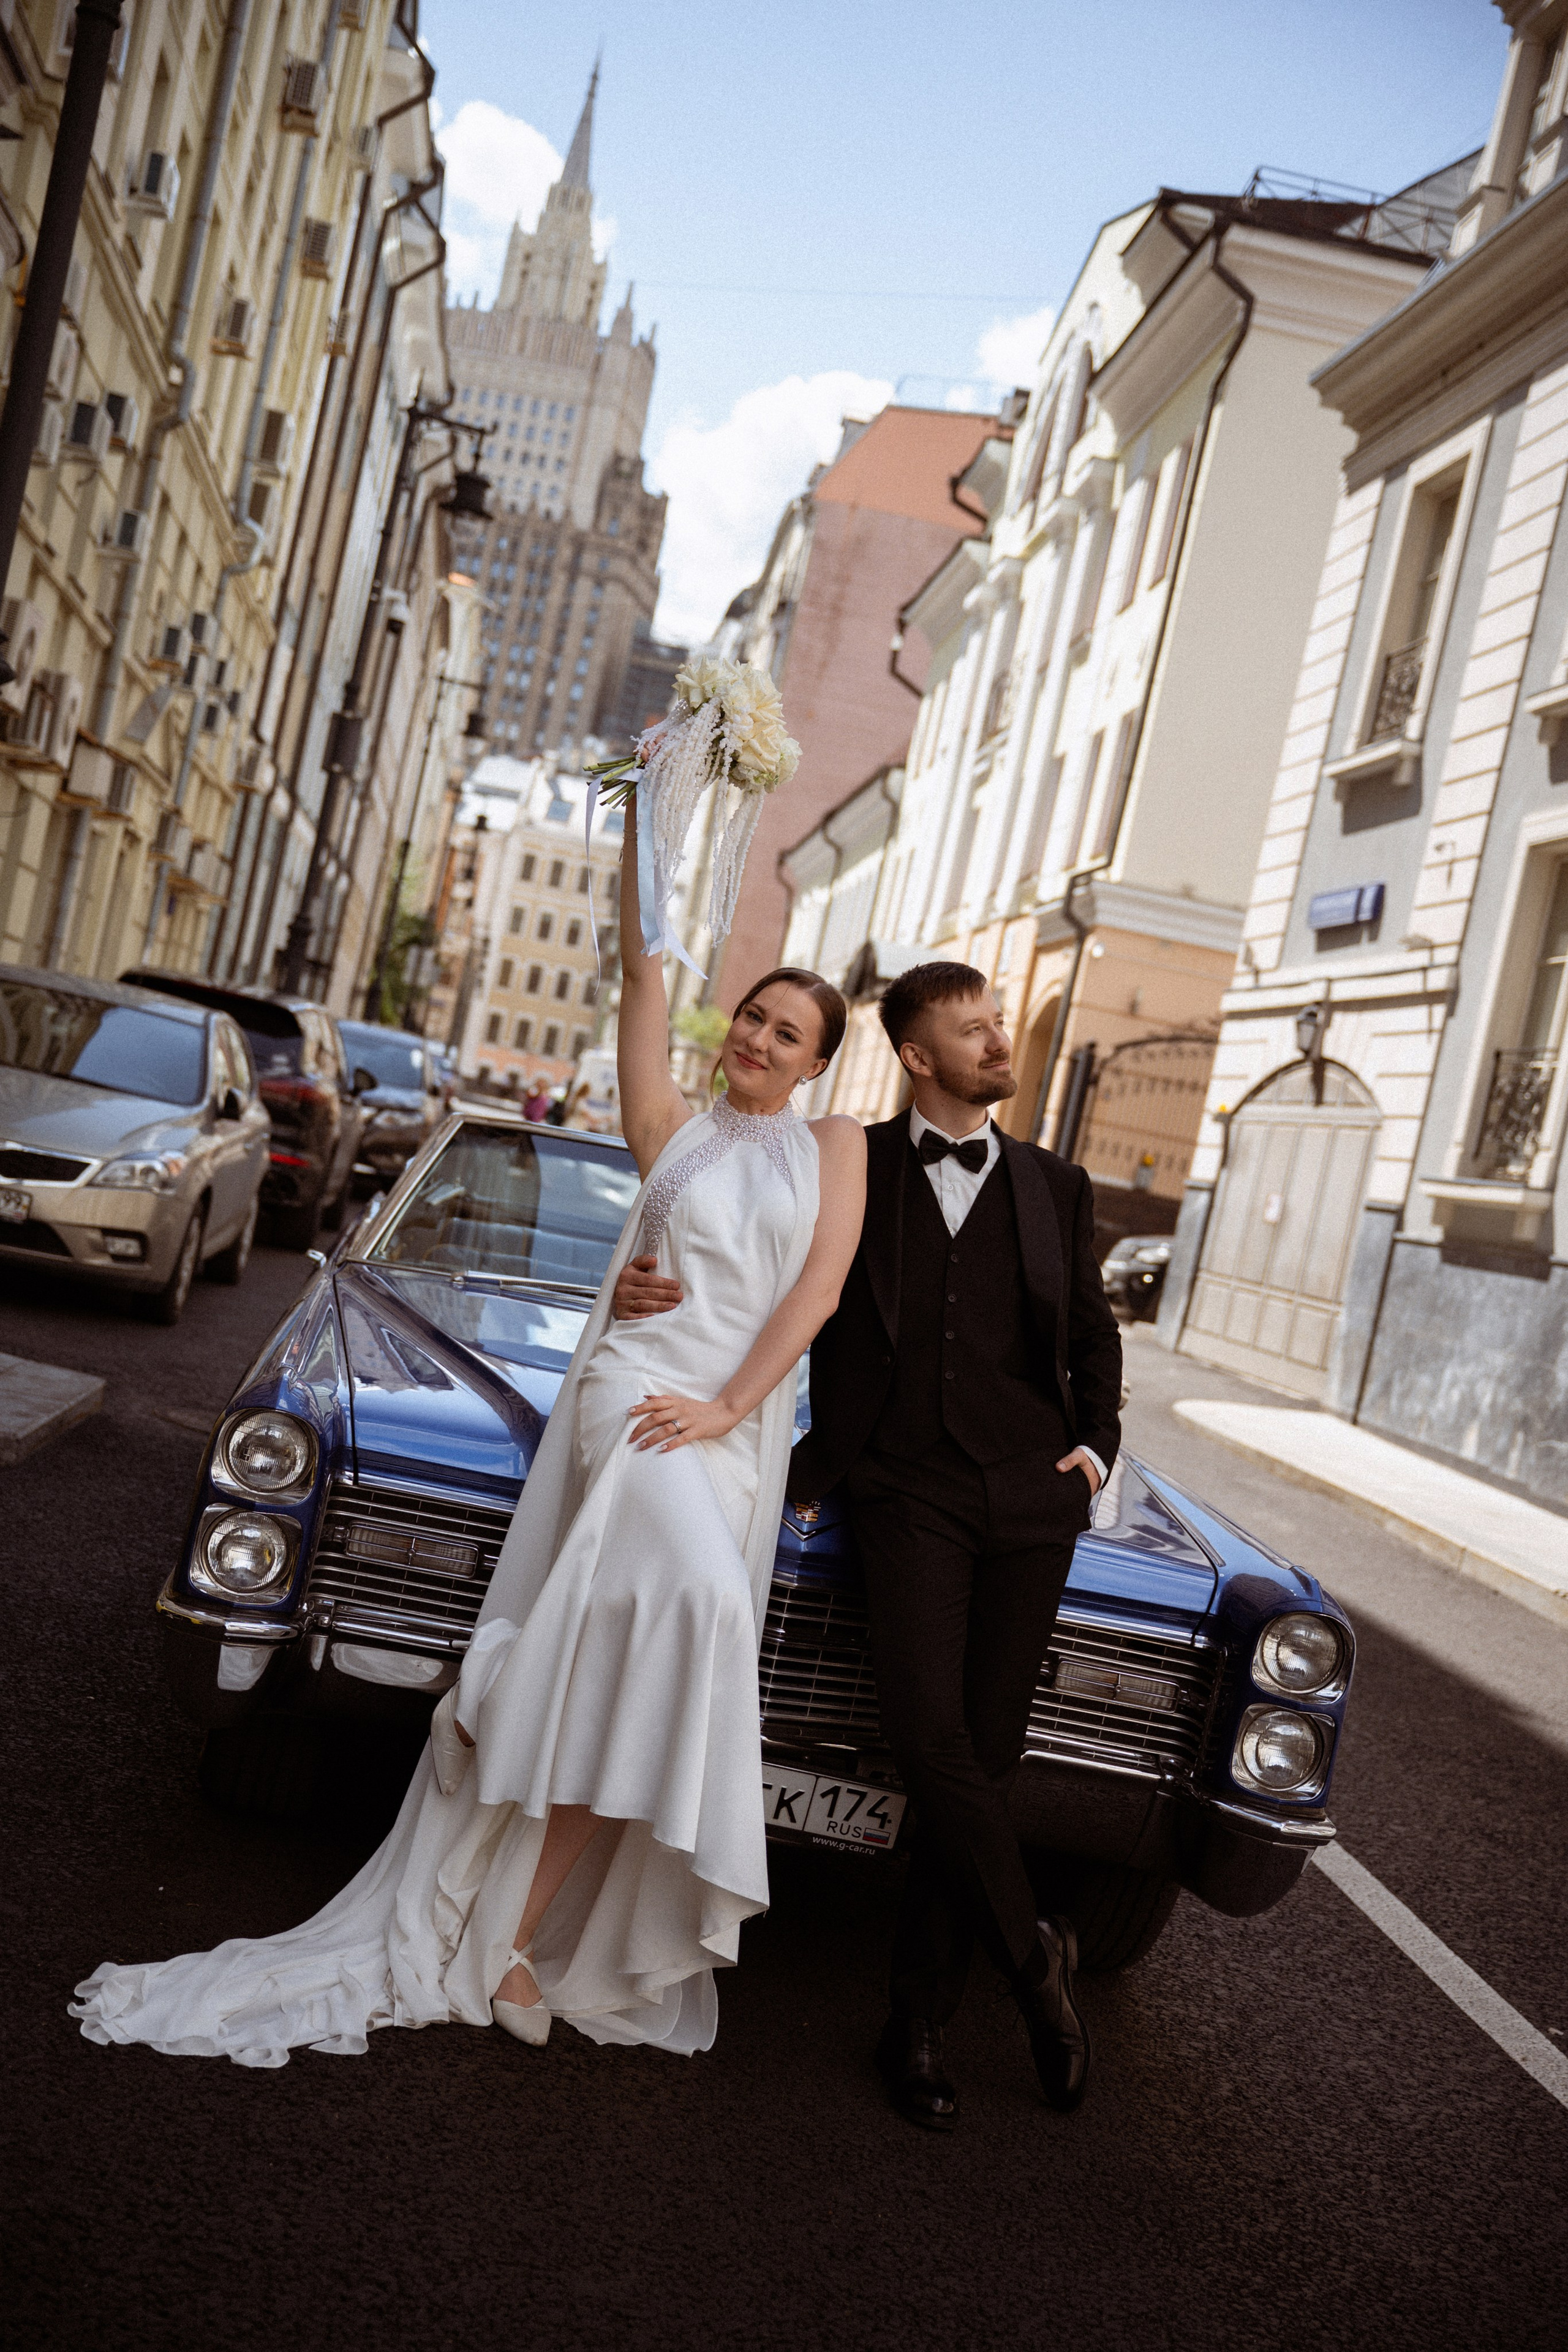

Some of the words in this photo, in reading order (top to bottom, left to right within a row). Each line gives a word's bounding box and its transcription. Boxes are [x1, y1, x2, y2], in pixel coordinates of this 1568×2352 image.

[820, 1784, 889, 1829] 174
[826, 1820, 862, 1839] RUS
[812, 1836, 876, 1855] www.g-car.ru
